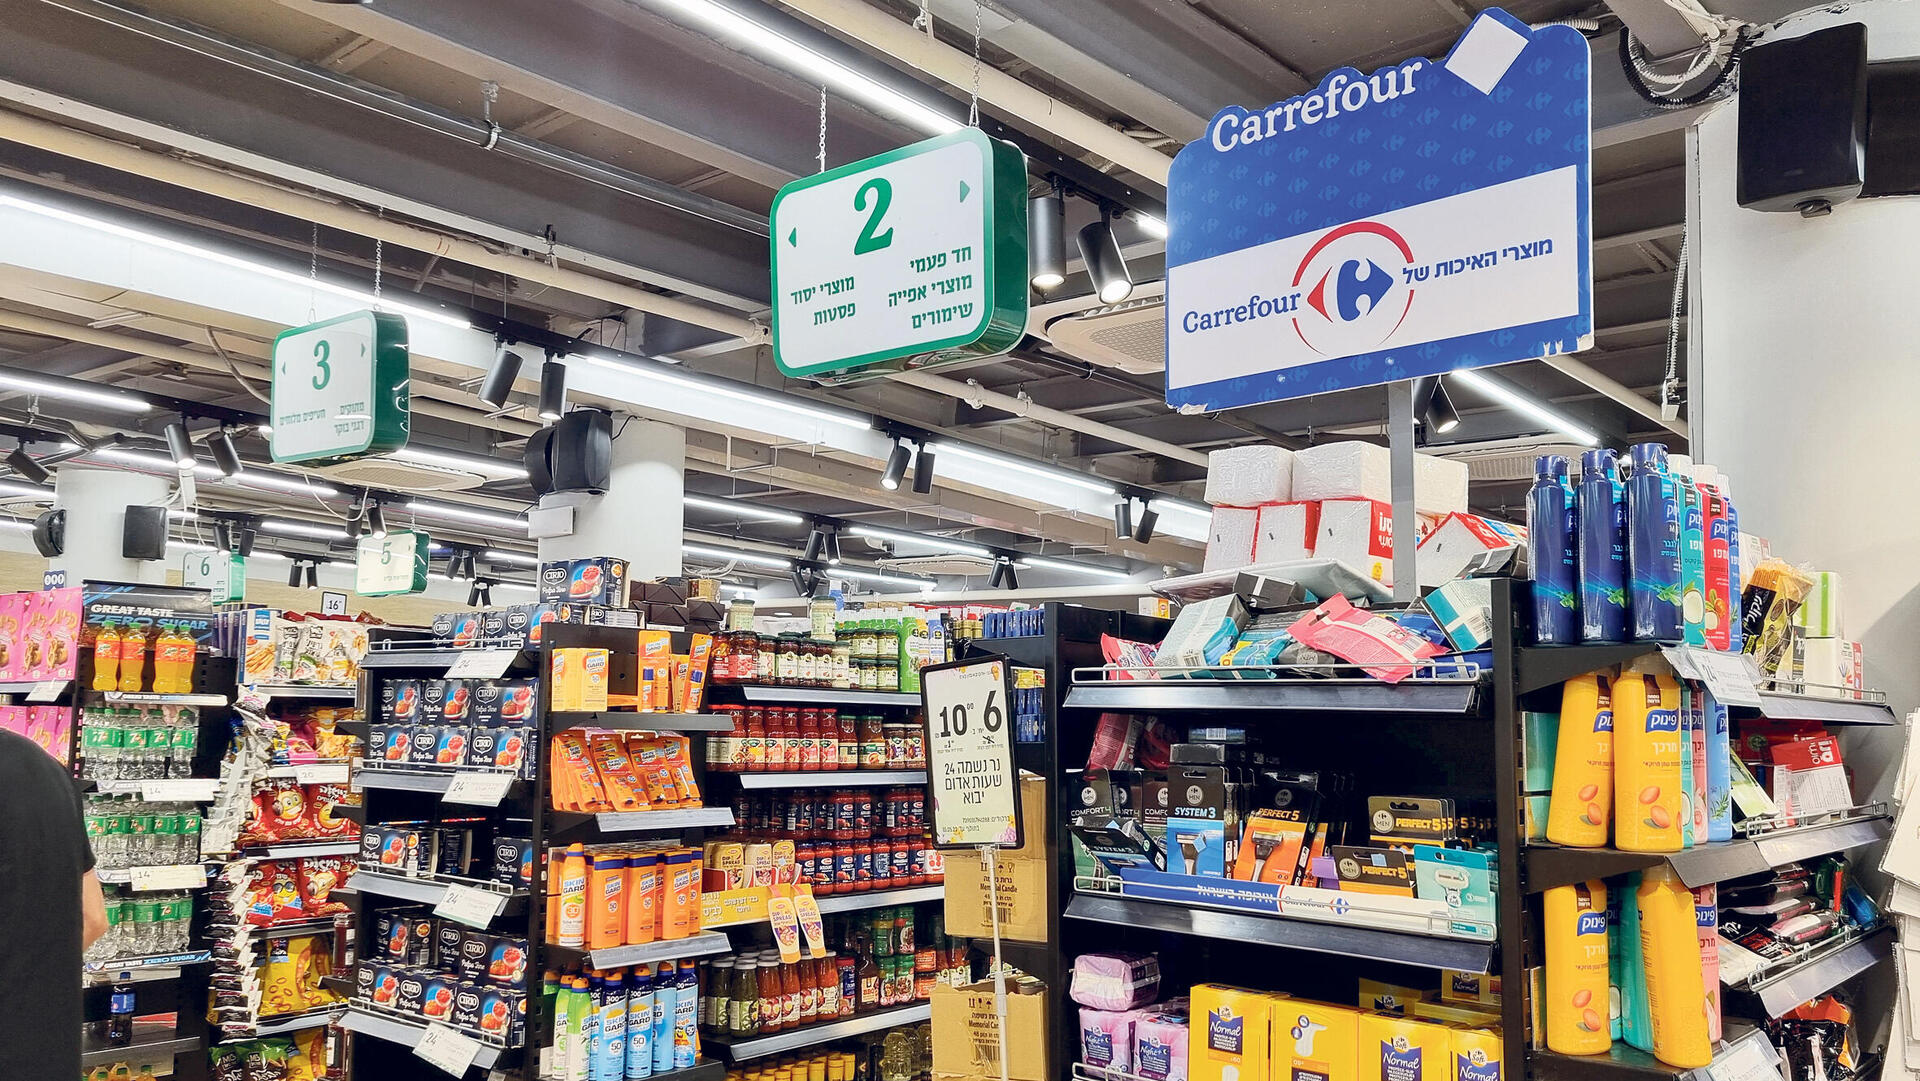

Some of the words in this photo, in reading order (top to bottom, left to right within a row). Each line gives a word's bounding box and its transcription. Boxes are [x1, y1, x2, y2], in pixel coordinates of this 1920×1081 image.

[1211, 61, 1423, 152] Carrefour
[854, 177, 893, 256] 2
[951, 246, 972, 262] חד
[1503, 237, 1553, 263] מוצרי
[910, 251, 947, 273] פעמי
[1435, 246, 1498, 278] האיכות
[1402, 261, 1430, 286] של
[820, 276, 855, 296] מוצרי
[931, 274, 972, 295] מוצרי
[791, 286, 816, 304] יסוד
[888, 285, 928, 307] אפייה
[813, 303, 856, 326] פסטות
[911, 302, 973, 329] שימורים
[1183, 292, 1302, 334] Carrefour
[312, 340, 331, 390] 3
[381, 541, 392, 565] 5
[201, 555, 210, 577] 6
[544, 570, 566, 582] CIRIO
[90, 603, 135, 615] GREAT
[136, 607, 175, 618] TASTE
[86, 614, 154, 627] ZERO
[156, 617, 209, 631] SUGAR
[486, 620, 502, 630] CIRIO
[508, 615, 526, 625] CIRIO
[435, 623, 451, 632] CIRIO
[427, 690, 442, 698] CIRIO
[478, 689, 496, 698] CIRIO
[966, 702, 975, 710] 00
[983, 690, 1002, 733] 6
[939, 704, 968, 738] 10
[1651, 714, 1677, 729] פינוק
[415, 738, 434, 747] CIRIO
[474, 739, 492, 748] CIRIO
[1652, 742, 1678, 756] מרכך
[944, 762, 955, 776] 24
[957, 759, 988, 774] נשמה
[989, 758, 1001, 772] נר
[945, 776, 971, 791] אדום
[971, 774, 1002, 789] שעות
[963, 791, 985, 804] יבוא
[1071, 806, 1105, 816] COMFORT
[1174, 806, 1208, 816] SYSTEM
[1208, 806, 1216, 818] 3
[1258, 807, 1292, 818] PERFECT
[1291, 809, 1300, 821] 5
[1395, 818, 1432, 830] PERFECT
[1432, 818, 1443, 832] 5
[498, 848, 517, 857] CIRIO
[675, 874, 689, 883] SKIN
[1362, 865, 1398, 877] PERFECT
[1398, 866, 1408, 879] 5
[563, 877, 585, 887] SKIN
[606, 880, 621, 889] SKIN
[640, 883, 655, 892] GARD
[641, 878, 655, 886] SKIN
[674, 879, 689, 888] GARD
[1002, 884, 1018, 893] Candle
[562, 885, 585, 895] GARD
[605, 886, 621, 895] GARD
[678, 895, 687, 903] 50
[608, 902, 617, 910] 50
[1581, 916, 1606, 932] פינוק
[442, 931, 459, 941] CIRIO
[465, 944, 485, 954] CIRIO
[1699, 938, 1716, 949] מרכ
[1584, 944, 1606, 959] מרכך
[143, 956, 169, 965] ZERO
[170, 954, 196, 962] SUGAR
[402, 984, 420, 994] CIRIO
[1453, 981, 1478, 992] Normal
[458, 996, 478, 1007] CIRIO
[628, 1016, 651, 1026] GARD
[629, 1010, 651, 1019] SKIN
[968, 1019, 991, 1029] Memorial
[1210, 1020, 1241, 1037] Normal
[426, 1032, 438, 1045] 24
[633, 1037, 645, 1045] 50
[610, 1042, 622, 1051] 50
[1394, 1040, 1407, 1051] Soft
[1383, 1052, 1419, 1070] Normal
[1471, 1053, 1485, 1064] Soft
[1459, 1066, 1498, 1081] Normal
